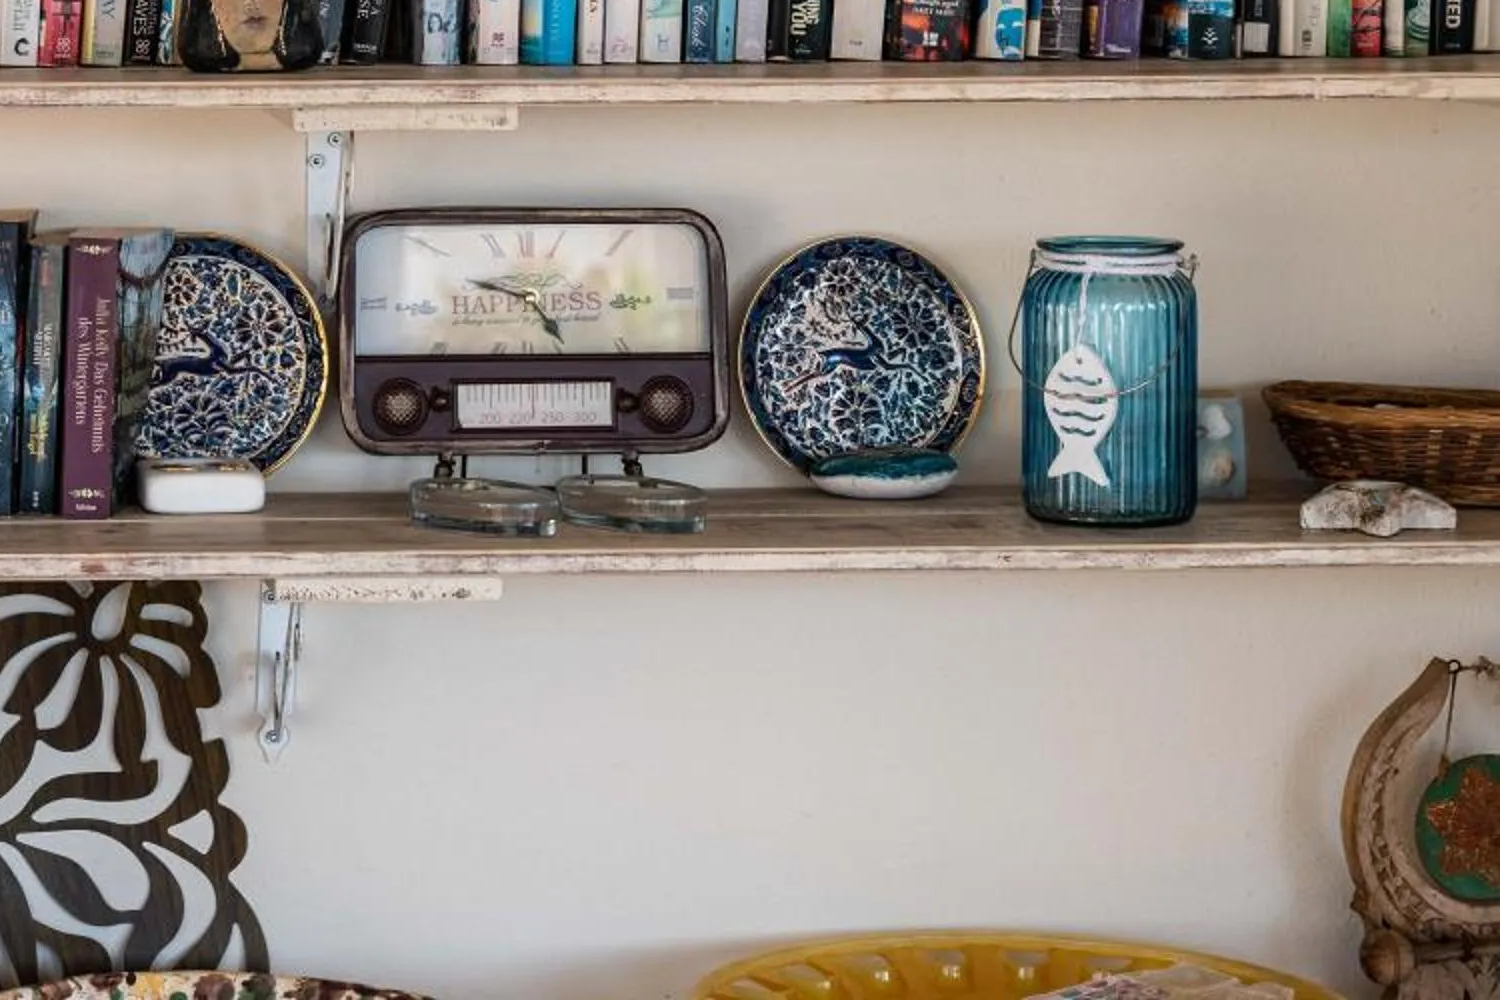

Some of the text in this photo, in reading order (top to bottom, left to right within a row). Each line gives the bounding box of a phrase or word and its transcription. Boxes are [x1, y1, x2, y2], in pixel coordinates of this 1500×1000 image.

[691, 4, 709, 50] Cloak
[790, 1, 810, 36] YOU
[74, 316, 92, 426] des Wintergartens
[91, 360, 109, 453] Das Geheimnis
